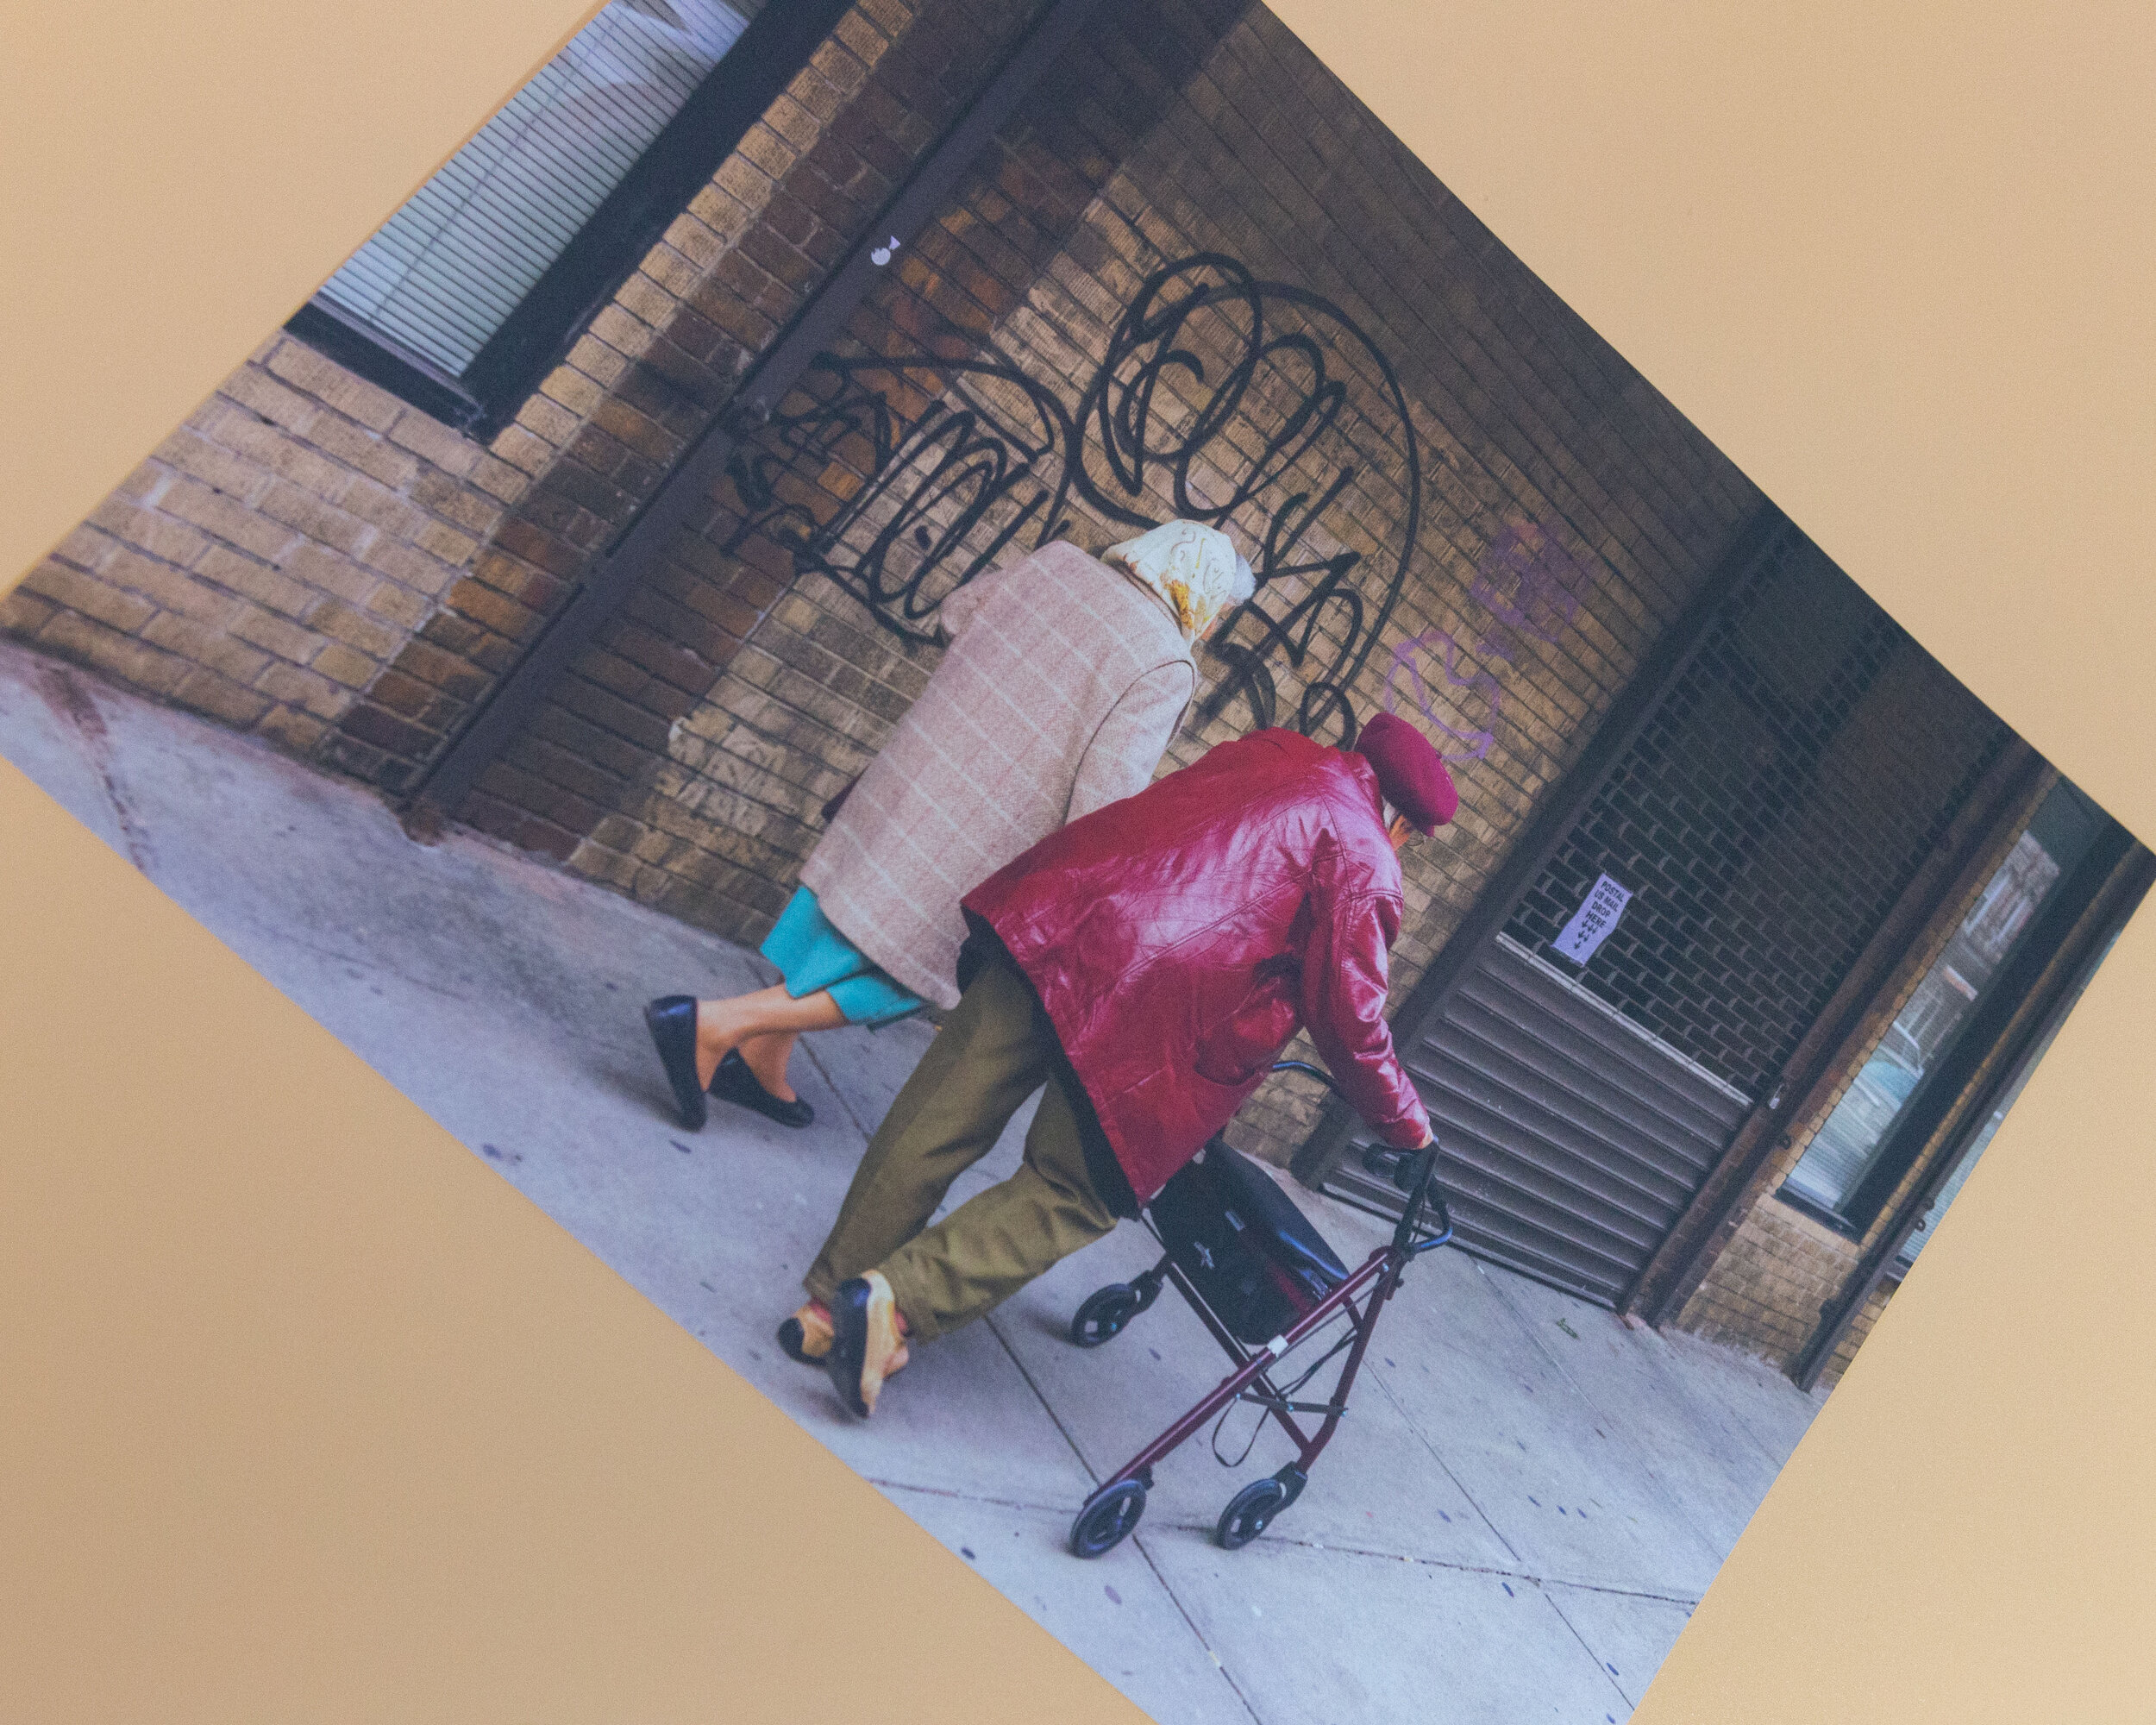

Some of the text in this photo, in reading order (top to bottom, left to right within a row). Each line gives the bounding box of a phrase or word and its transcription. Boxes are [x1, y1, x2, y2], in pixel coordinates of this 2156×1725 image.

[1594, 889, 1620, 913] US MAIL
[1601, 881, 1625, 902] POSTAL
[1591, 900, 1611, 918] DROP
[1585, 911, 1607, 928] HERE
